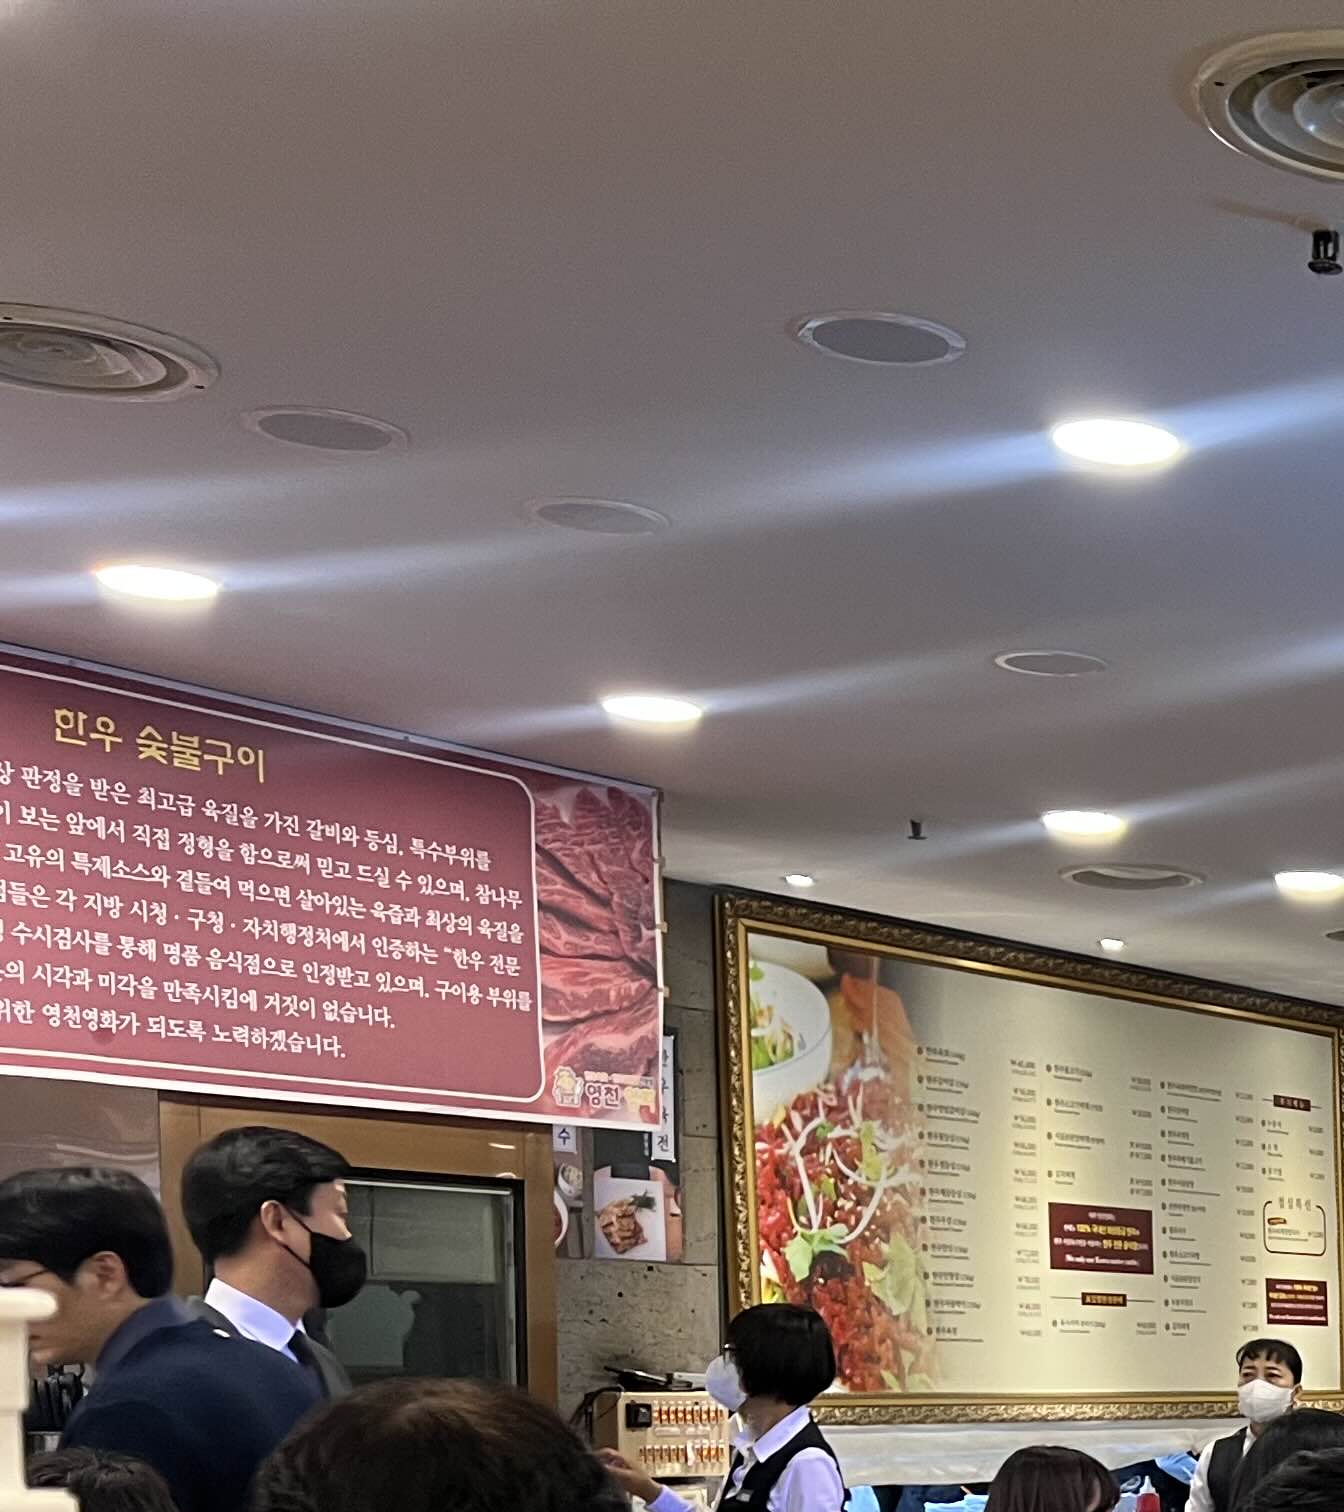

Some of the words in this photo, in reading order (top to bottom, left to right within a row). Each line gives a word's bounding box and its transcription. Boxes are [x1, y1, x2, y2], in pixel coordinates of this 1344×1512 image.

[55, 708, 122, 752] 한우
[136, 725, 264, 783] 숯불구이
[18, 805, 61, 831] 보는
[65, 811, 126, 844] 앞에서
[132, 824, 171, 852] 직접
[178, 832, 235, 862] 정형을
[238, 842, 311, 876] 함으로써
[316, 857, 352, 880] 믿고
[356, 865, 391, 889] 드실
[395, 870, 413, 892] 수
[475, 884, 523, 910] 참나무
[21, 765, 84, 797] 판정을
[90, 777, 131, 805] 받은
[138, 787, 196, 817] 최고급
[201, 799, 259, 829] 육질을
[264, 811, 301, 837] 가진
[306, 819, 360, 847] 갈비와
[409, 837, 491, 872] 특수부위를
[3, 843, 65, 873] 고유의
[71, 851, 171, 888] 특제소스와
[176, 870, 231, 899] 곁들여
[238, 880, 291, 908] 먹으면
[296, 888, 367, 919] 살아있는
[369, 901, 422, 928] 육즙과
[425, 909, 473, 936] 최상의
[476, 918, 525, 945] 육질을
[55, 889, 78, 913] 각
[83, 892, 123, 920] 지방
[130, 900, 167, 926] 시청
[187, 908, 224, 935] 구청
[242, 916, 366, 955] 자치행정처에서
[372, 937, 438, 965] 인증하는
[489, 954, 521, 977] 전문
[0, 960, 25, 985] 의
[32, 963, 93, 992] 시각과
[98, 972, 158, 1000] 미각을
[163, 979, 258, 1012] 만족시킴에
[264, 992, 316, 1019] 거짓이
[322, 1000, 396, 1029] 없습니다.
[11, 921, 113, 956] 수시검사를
[116, 935, 157, 963] 통해
[163, 943, 201, 968] 명품
[205, 948, 298, 979] 음식점으로
[302, 961, 371, 989] 인정받고
[434, 979, 484, 1006] 구이용
[486, 987, 532, 1012] 부위를
[42, 1003, 140, 1036] 영천영화가
[147, 1015, 207, 1043] 되도록
[211, 1024, 346, 1059] 노력하겠습니다.
